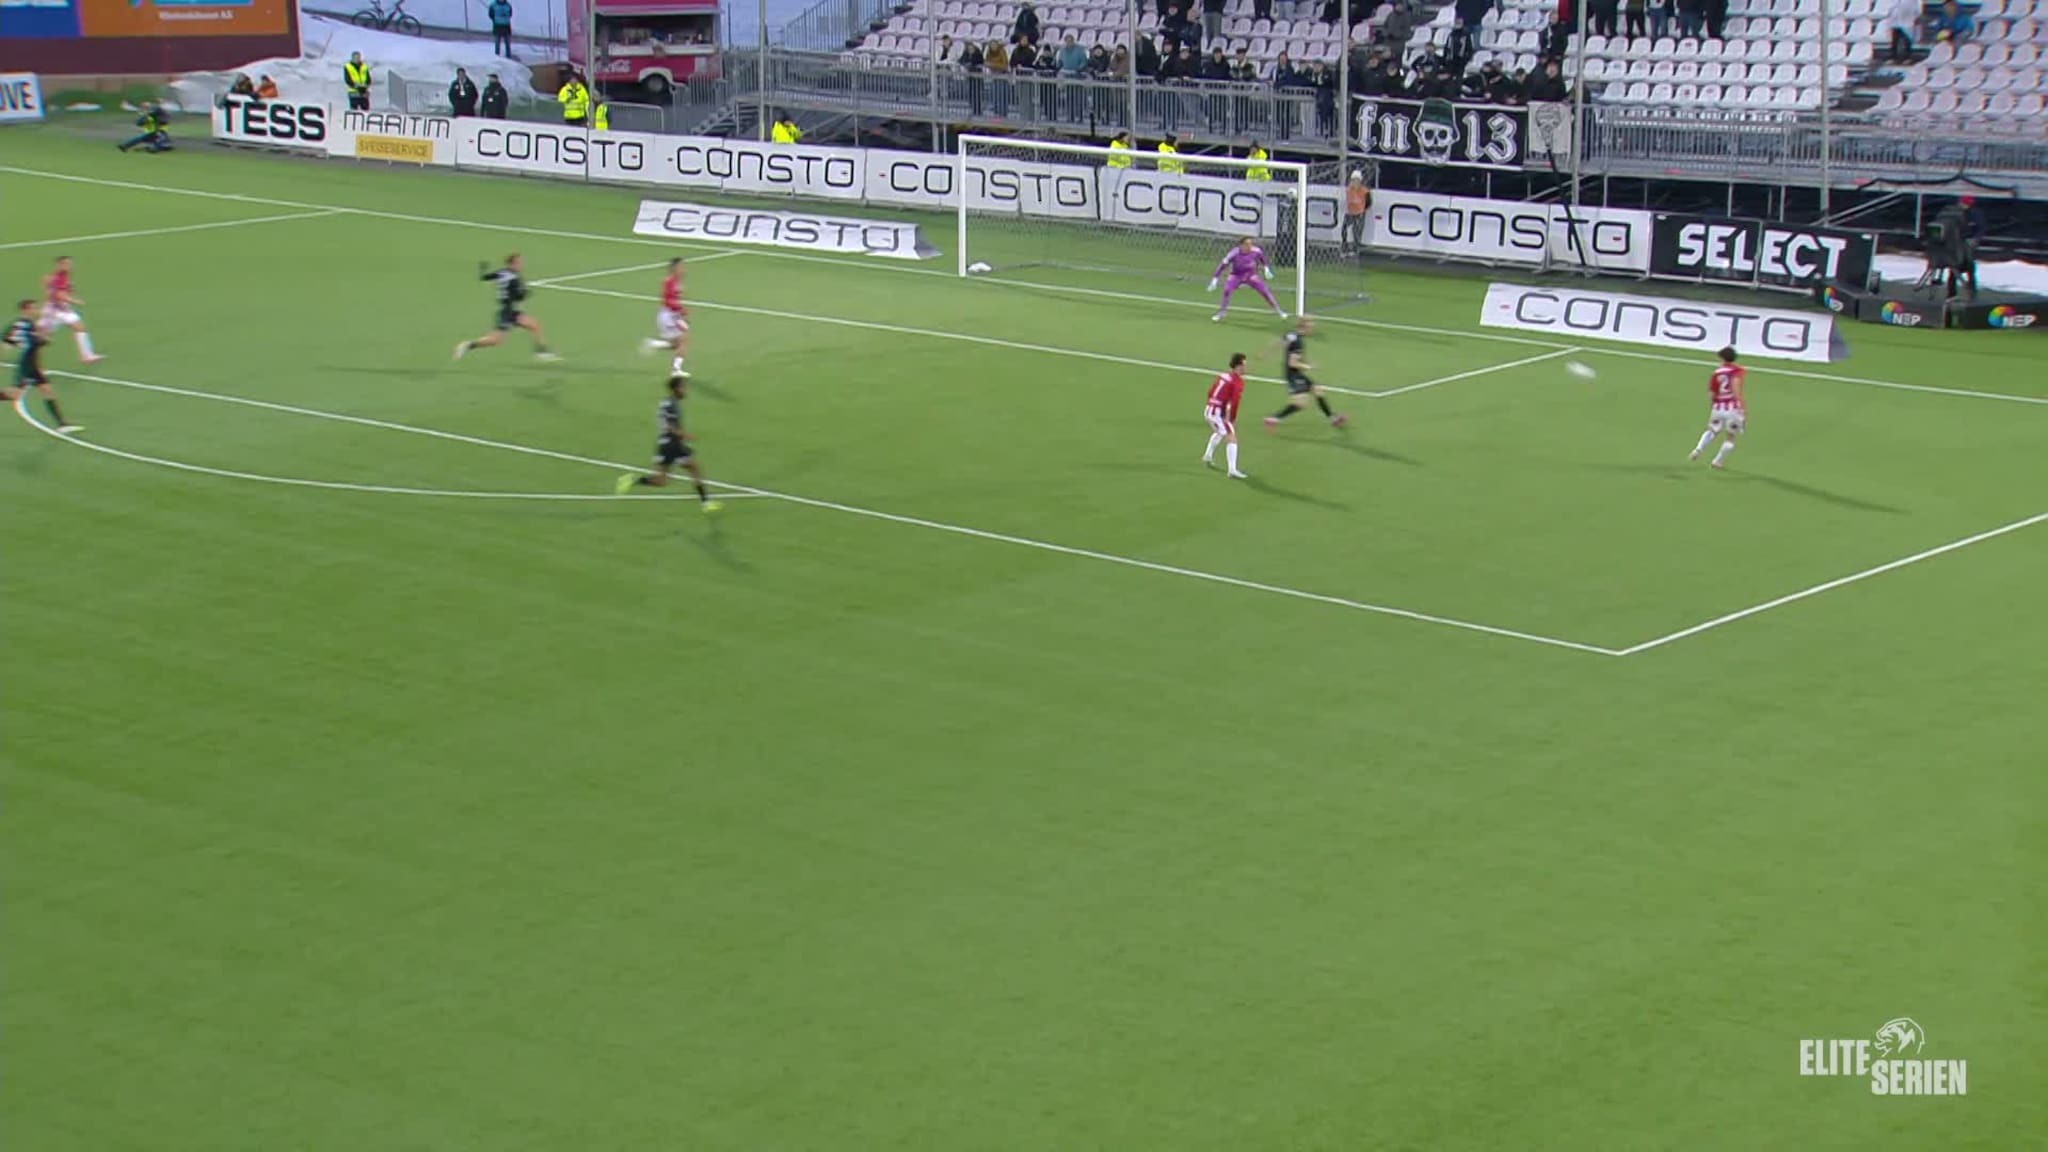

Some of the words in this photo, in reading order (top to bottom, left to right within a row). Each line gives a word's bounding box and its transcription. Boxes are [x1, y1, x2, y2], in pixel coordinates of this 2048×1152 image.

[222, 100, 326, 141] TESS
[343, 111, 450, 139] MARITIM
[1462, 109, 1518, 163] 13
[1678, 223, 1847, 279] SELECT
[1718, 374, 1733, 394] 2
